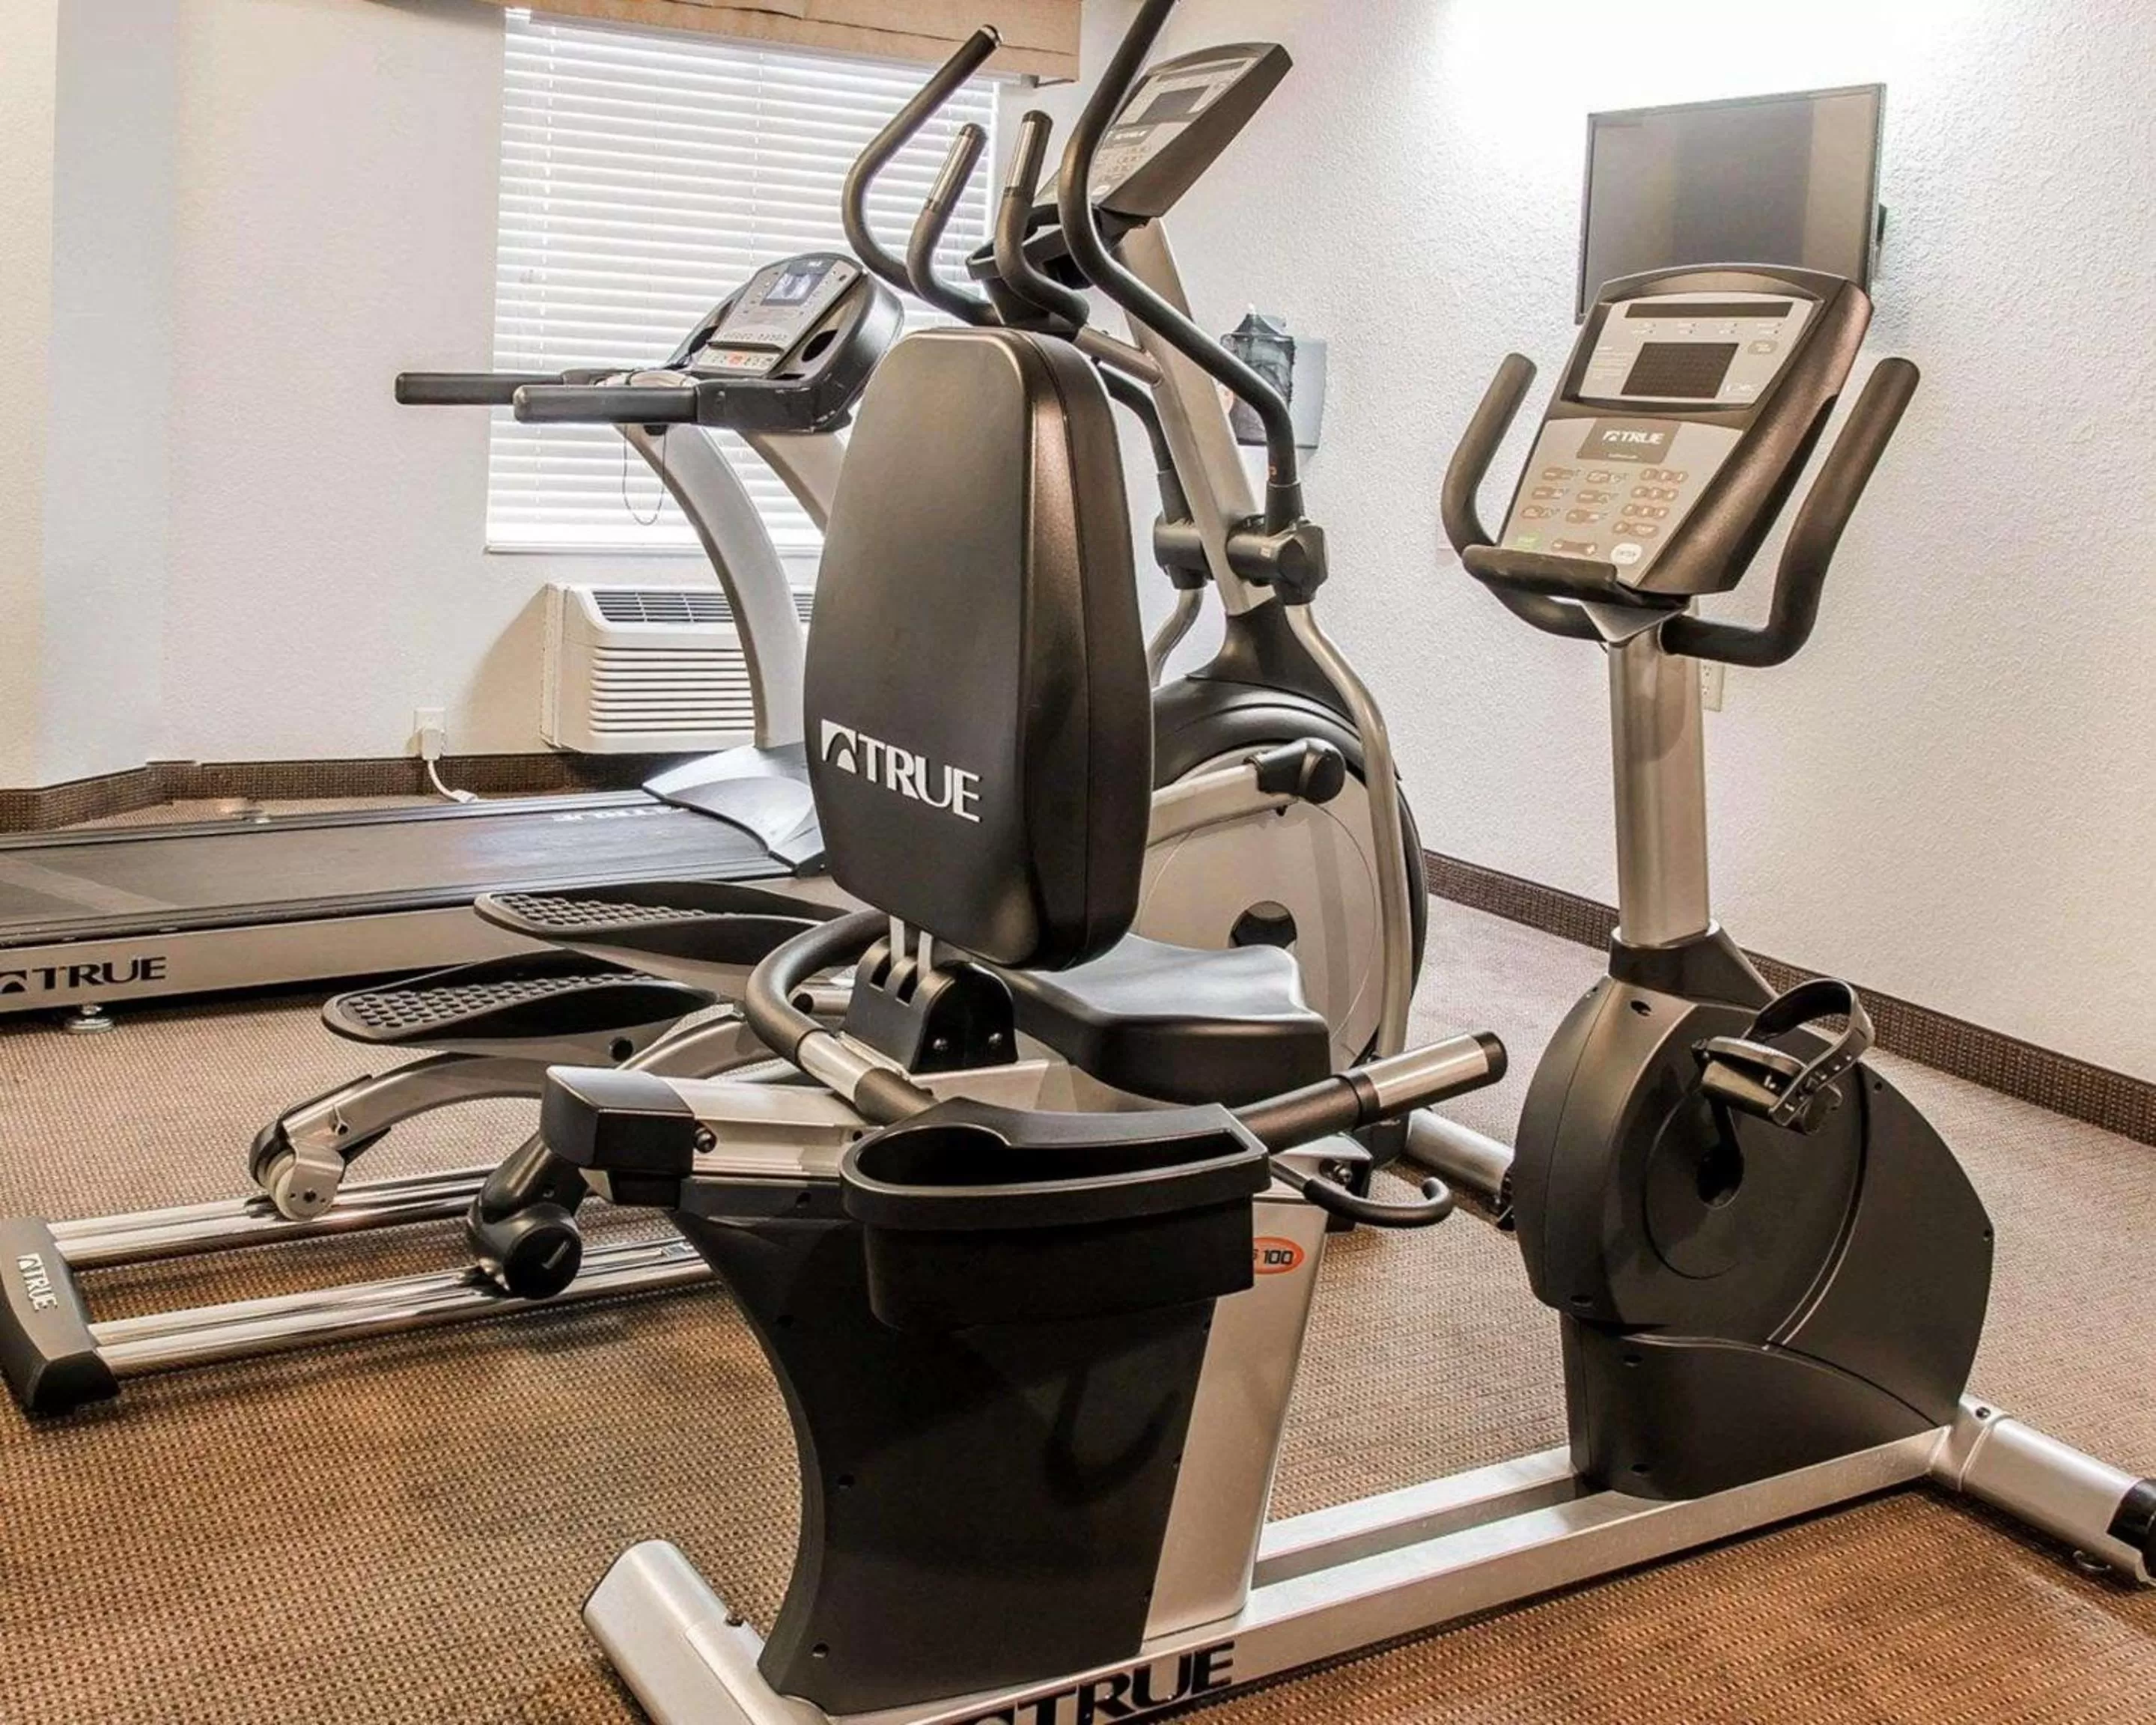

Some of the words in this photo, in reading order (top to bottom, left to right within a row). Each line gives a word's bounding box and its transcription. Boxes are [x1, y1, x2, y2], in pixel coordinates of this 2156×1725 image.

[858, 733, 980, 823] TRUE
[32, 957, 166, 990] TRUE
[1264, 1250, 1294, 1265] 100
[23, 1267, 58, 1311] TRUE
[1017, 1640, 1234, 1725] TRUE
